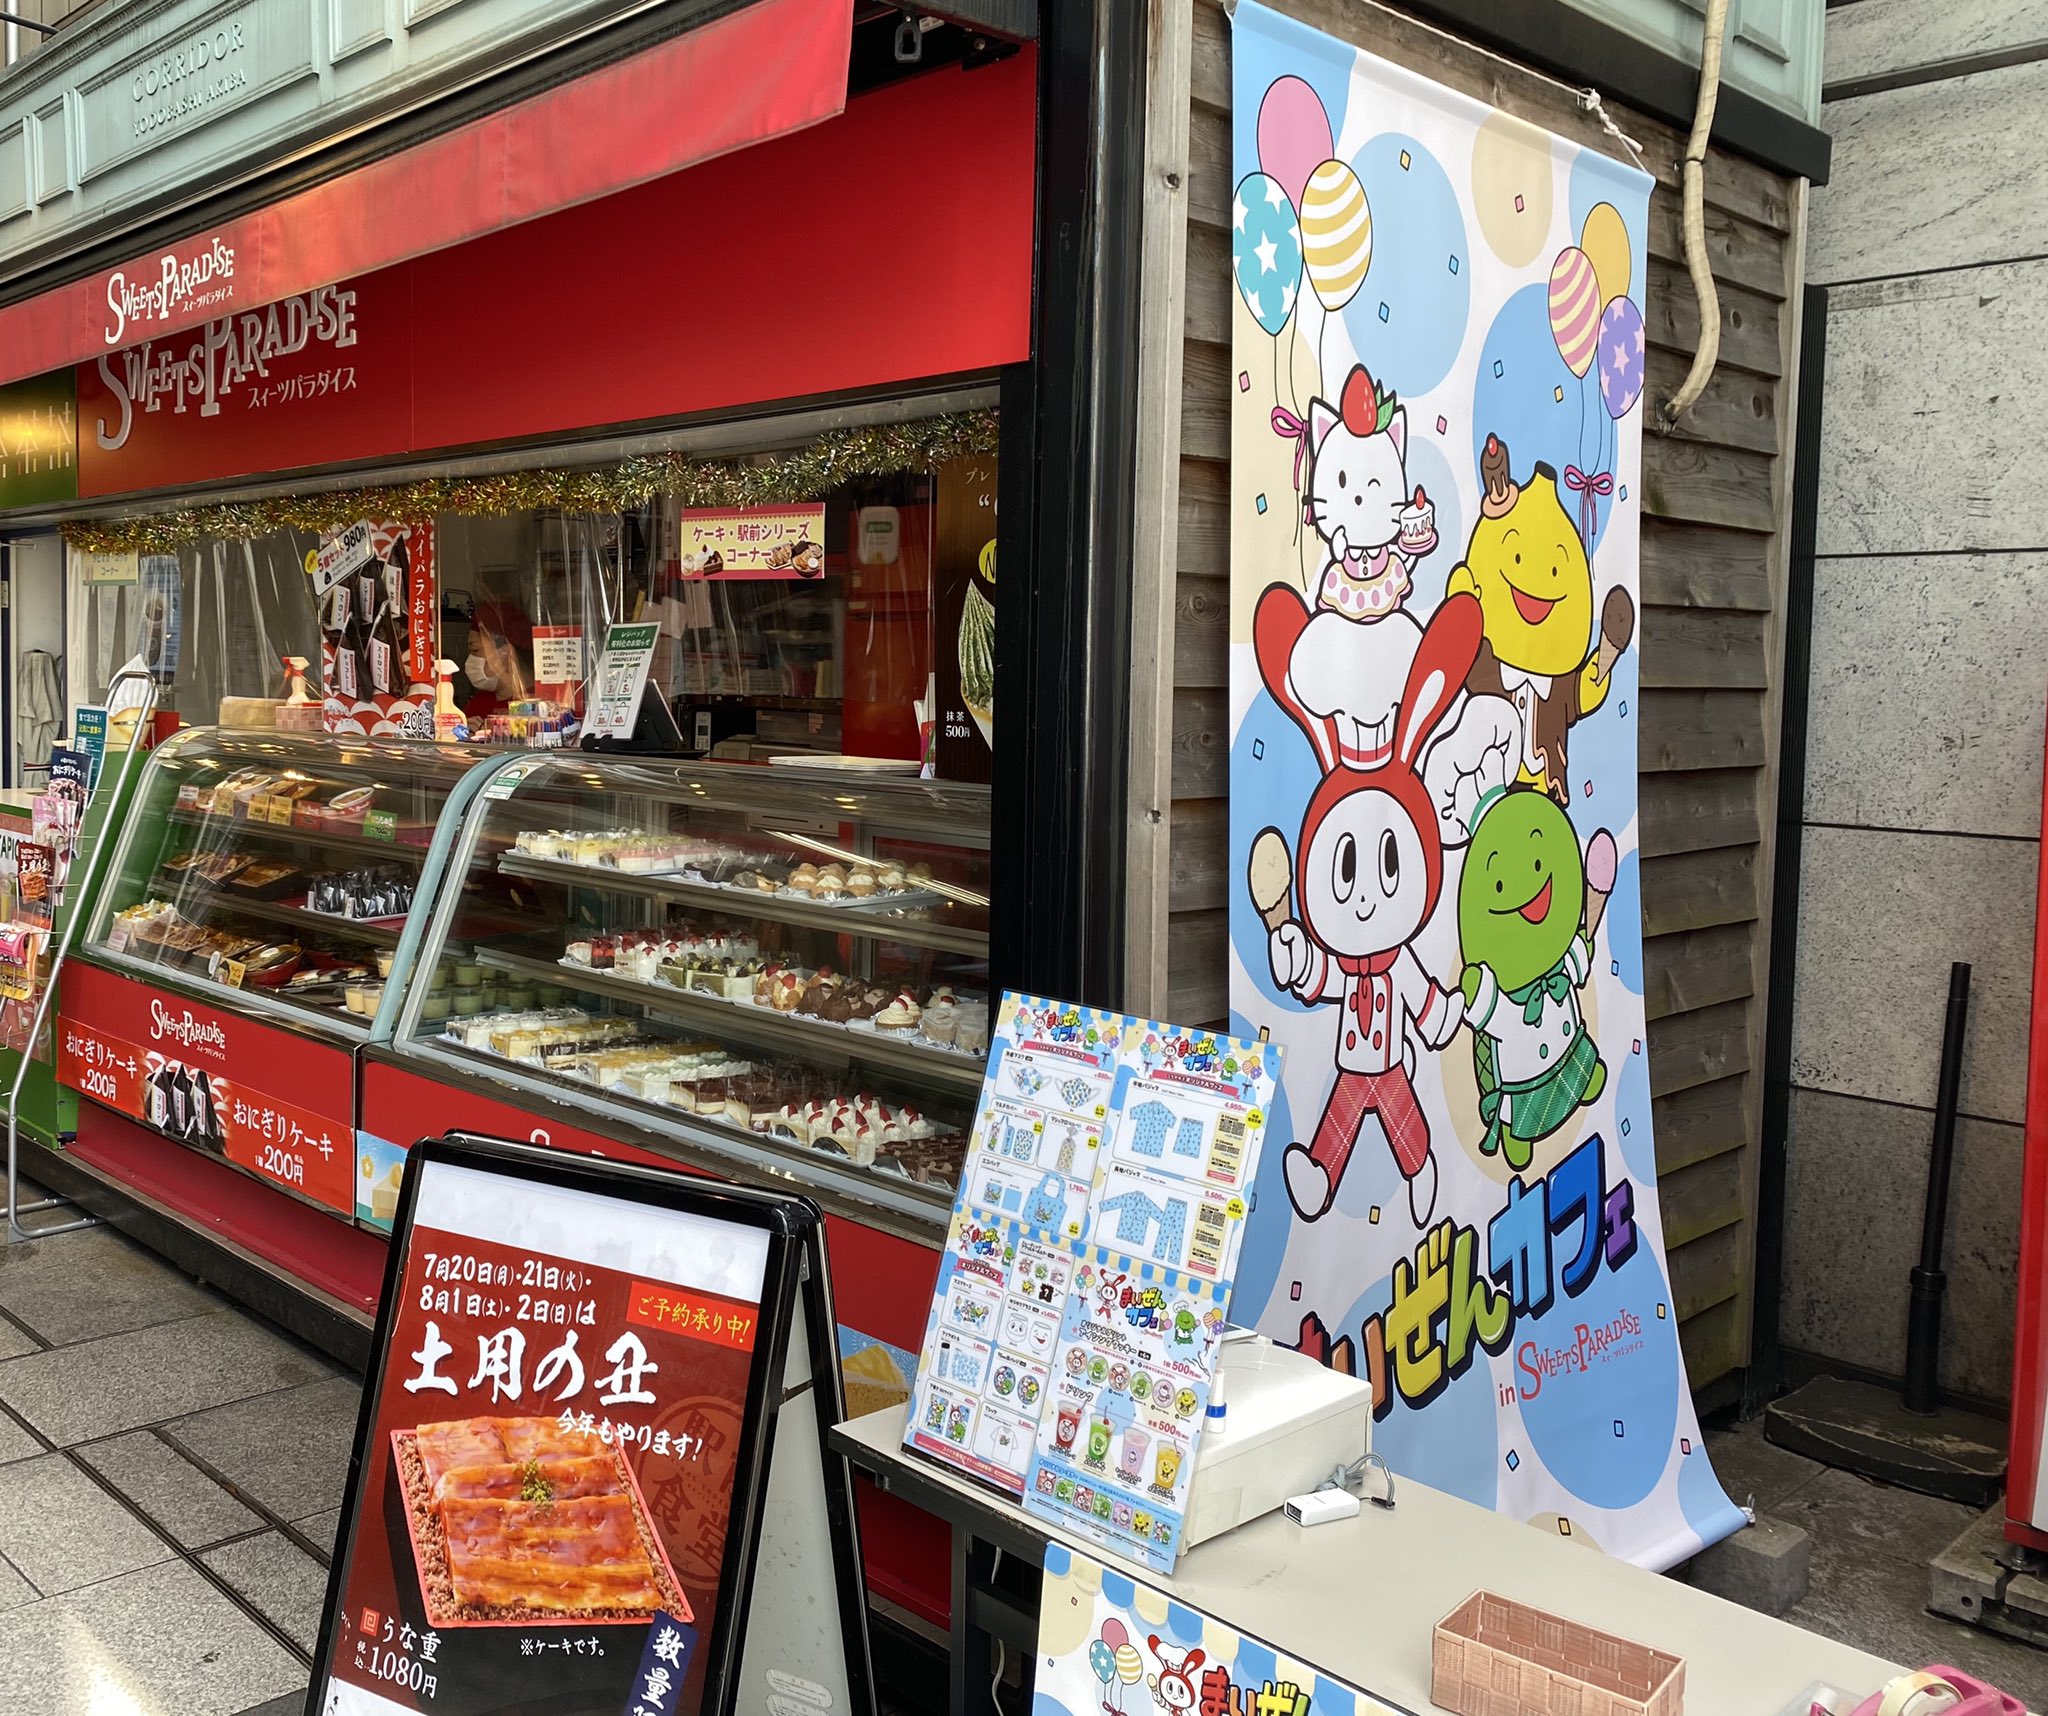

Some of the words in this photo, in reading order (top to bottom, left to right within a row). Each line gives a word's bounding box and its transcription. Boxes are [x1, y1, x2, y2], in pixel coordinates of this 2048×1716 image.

[132, 22, 245, 102] CORRIDOR
[133, 90, 203, 138] YODOBASHI
[206, 67, 247, 103] AKIBA
[693, 522, 810, 543] ケーキ・駅前シリーズ
[726, 547, 773, 563] コーナー
[66, 1030, 138, 1080] おにぎりケーキ
[1177, 1037, 1220, 1059] まいぜん
[233, 1098, 334, 1162] おにぎりケーキ
[637, 1295, 751, 1344] ご予約承り中!
[1118, 1285, 1167, 1311] まいぜん
[1124, 1307, 1160, 1329] カフェ
[402, 1319, 659, 1408] 土用の丑
[1065, 1383, 1094, 1401] ドリンク
[1499, 1383, 1516, 1407] in
[555, 1406, 703, 1462] 今年もやります!
[382, 1615, 442, 1664] うな重
[519, 1637, 605, 1657] ※ケーキです。
[368, 1646, 438, 1699] 1,080円
[633, 1625, 685, 1716] 数量
